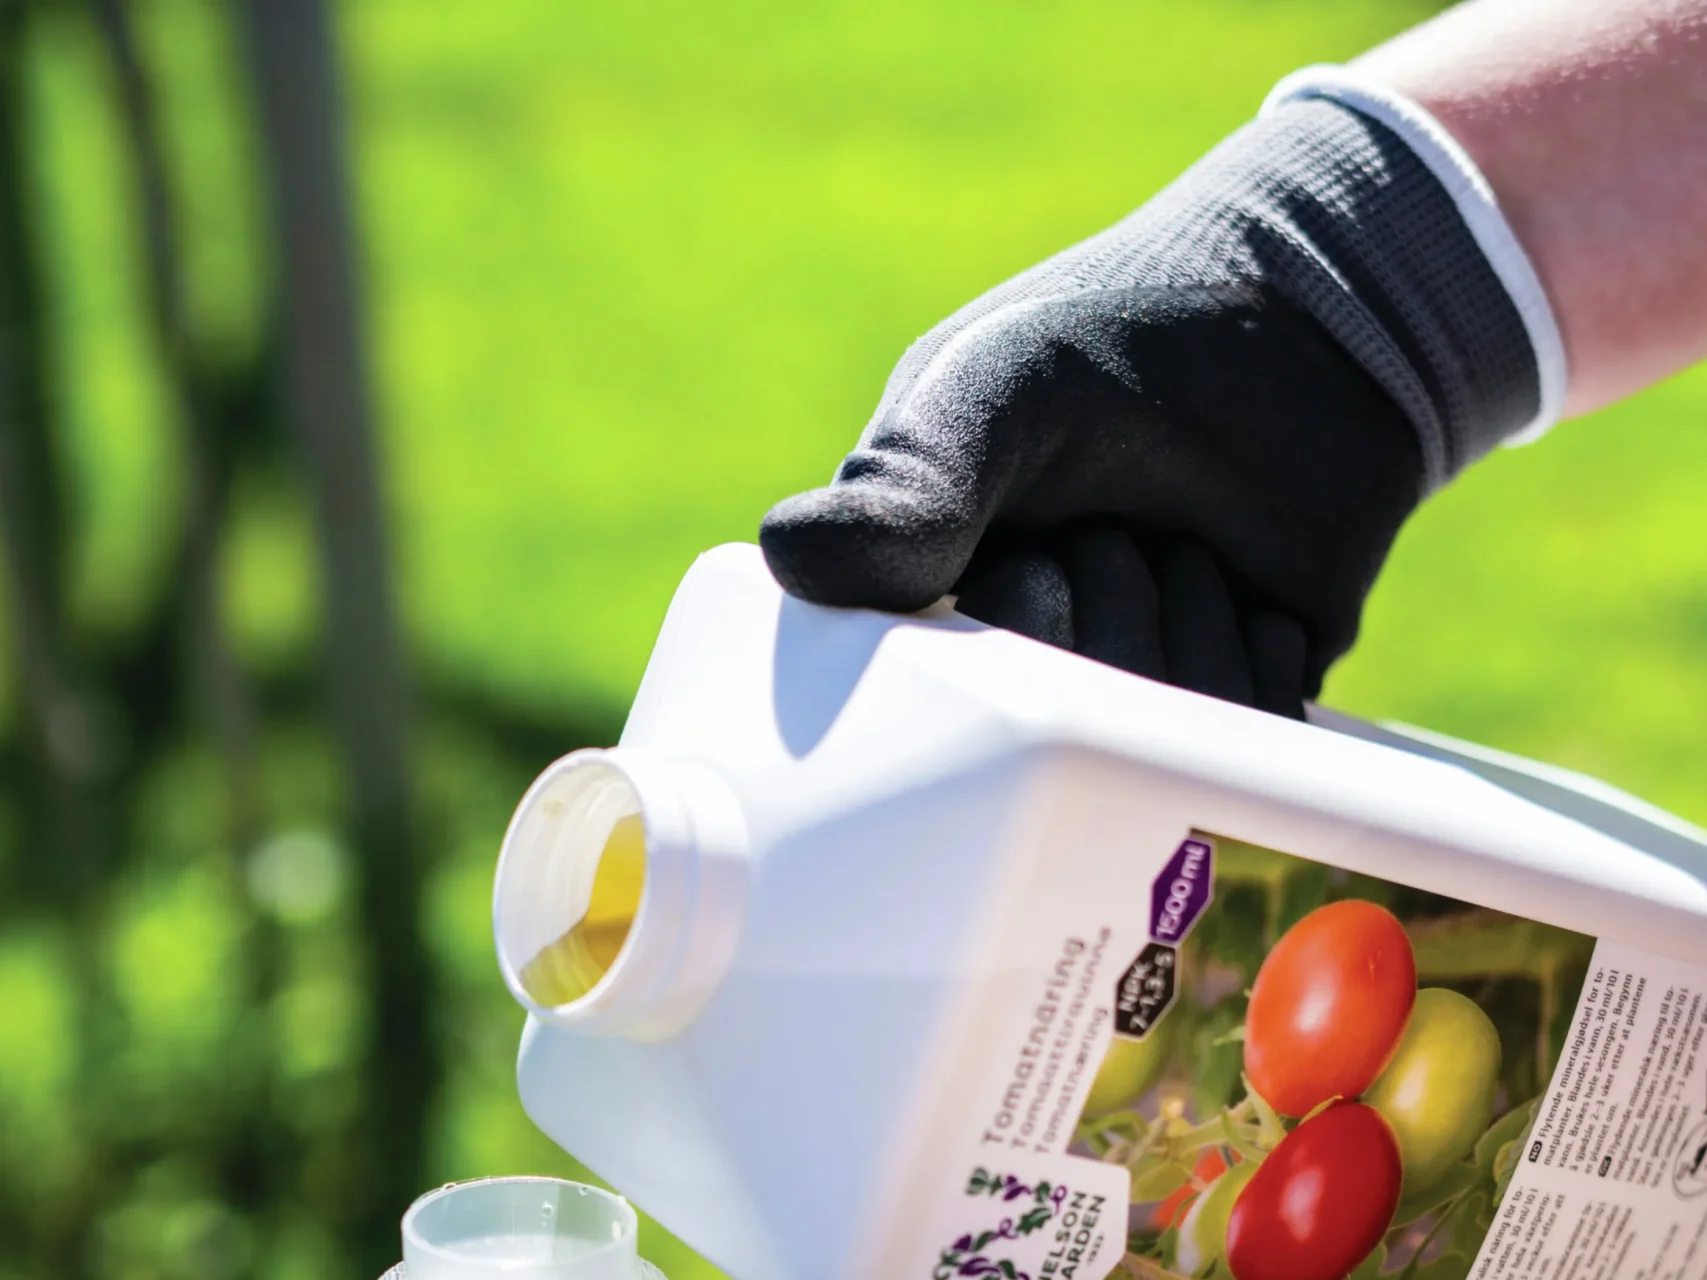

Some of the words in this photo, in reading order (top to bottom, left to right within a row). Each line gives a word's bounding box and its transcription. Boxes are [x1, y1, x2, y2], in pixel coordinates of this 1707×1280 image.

[1156, 876, 1192, 940] 1500
[1180, 843, 1208, 882] ml
[1118, 960, 1152, 1013] NPK
[1601, 1073, 1614, 1096] uker
[1611, 1043, 1625, 1070] etter
[1622, 1029, 1630, 1040] at
[1626, 977, 1646, 1026] plantene
[1665, 1027, 1676, 1040] 30
[980, 935, 1088, 1147] Tomatnäring
[1538, 1091, 1563, 1137] Flytende
[1560, 1006, 1593, 1088] mineralgjødsel
[1586, 987, 1599, 1002] for
[1593, 967, 1603, 983] to-
[1544, 1105, 1573, 1165] matplanter.
[1567, 1061, 1590, 1101] Blandes
[1587, 1026, 1603, 1053] vann,
[1596, 1009, 1606, 1022] 30
[1602, 975, 1617, 1007] ml/10
[1558, 1141, 1573, 1168] vann.
[1568, 1102, 1590, 1137] Brukes
[1583, 1075, 1599, 1098] hele
[1595, 1020, 1619, 1073] sesongen.
[1612, 974, 1633, 1015] Begynn
[1607, 1108, 1632, 1154] Flydende
[1648, 1017, 1667, 1054] næring
[1660, 1003, 1669, 1014] til
[1589, 1124, 1610, 1162] plantet
[1606, 1104, 1618, 1122] om.
[1489, 1221, 1511, 1254] näring
[1503, 1204, 1516, 1219] för
[1511, 1187, 1522, 1201] to-
[1510, 1225, 1522, 1236] 30
